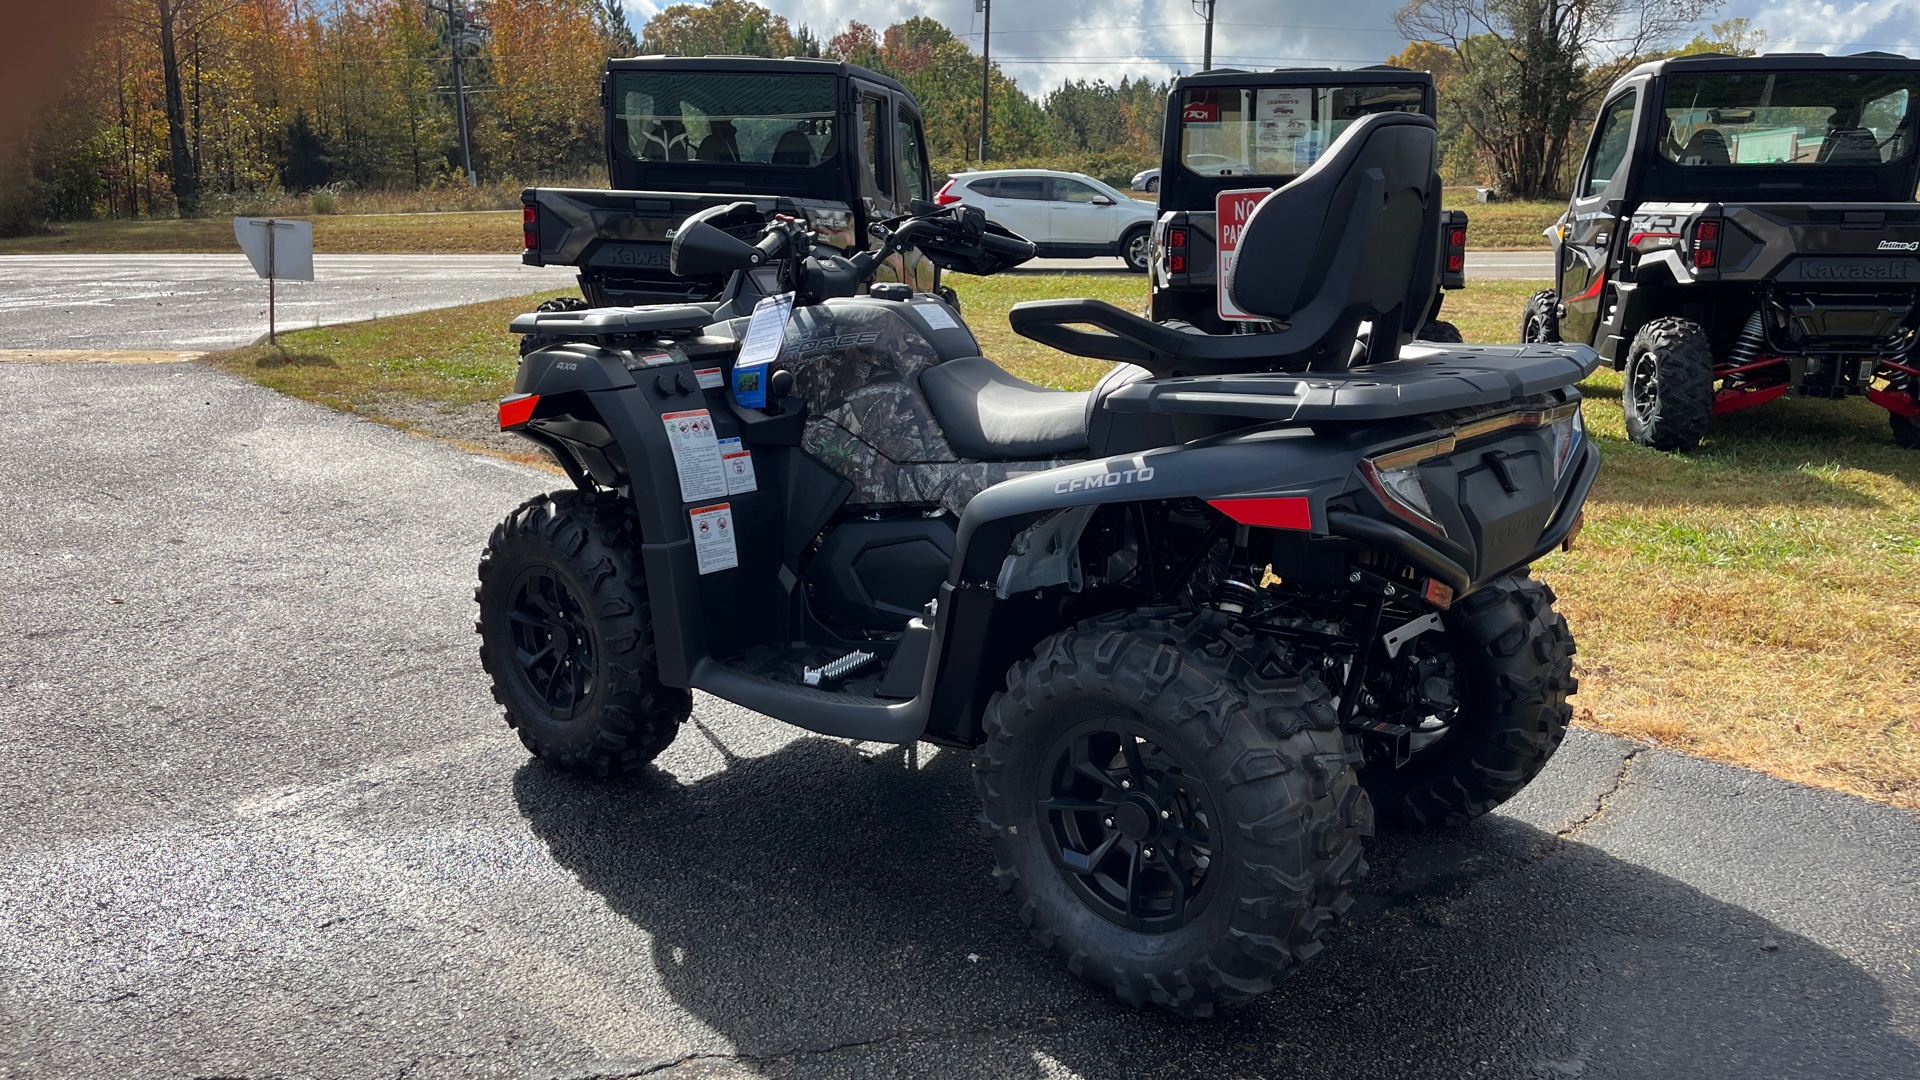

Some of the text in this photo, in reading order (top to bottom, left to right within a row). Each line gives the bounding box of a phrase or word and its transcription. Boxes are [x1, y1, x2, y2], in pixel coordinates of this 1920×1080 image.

[1235, 199, 1256, 221] NO
[609, 246, 671, 265] Kawas
[1801, 261, 1910, 279] Kawasaki
[1055, 467, 1155, 494] CFMOTO
